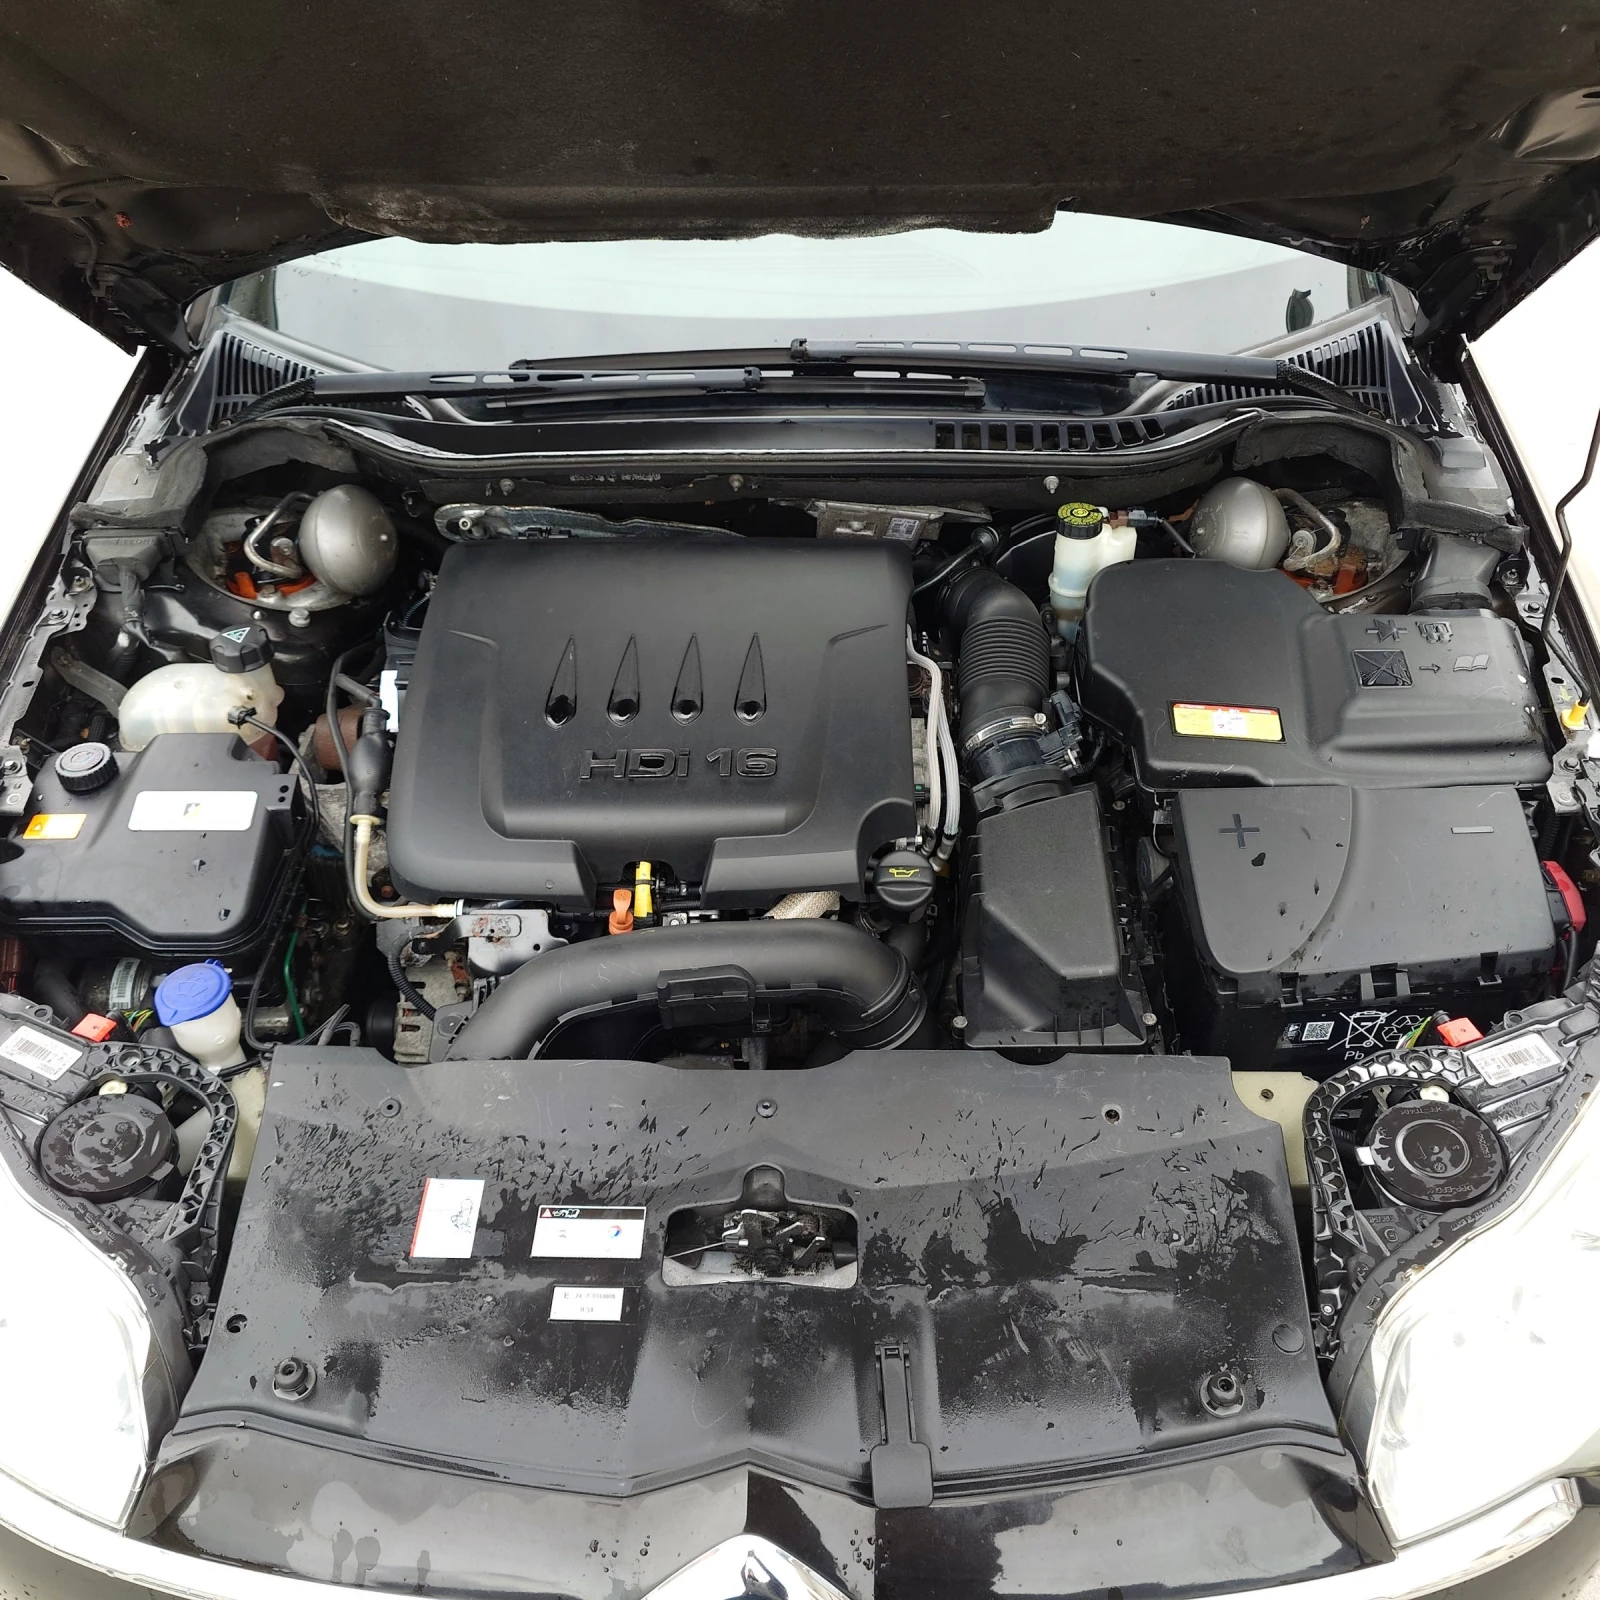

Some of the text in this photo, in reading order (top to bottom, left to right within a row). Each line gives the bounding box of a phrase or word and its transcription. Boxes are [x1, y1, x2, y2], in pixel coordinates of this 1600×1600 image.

[580, 748, 778, 779] HDi 16
[1344, 1050, 1365, 1061] Pb
